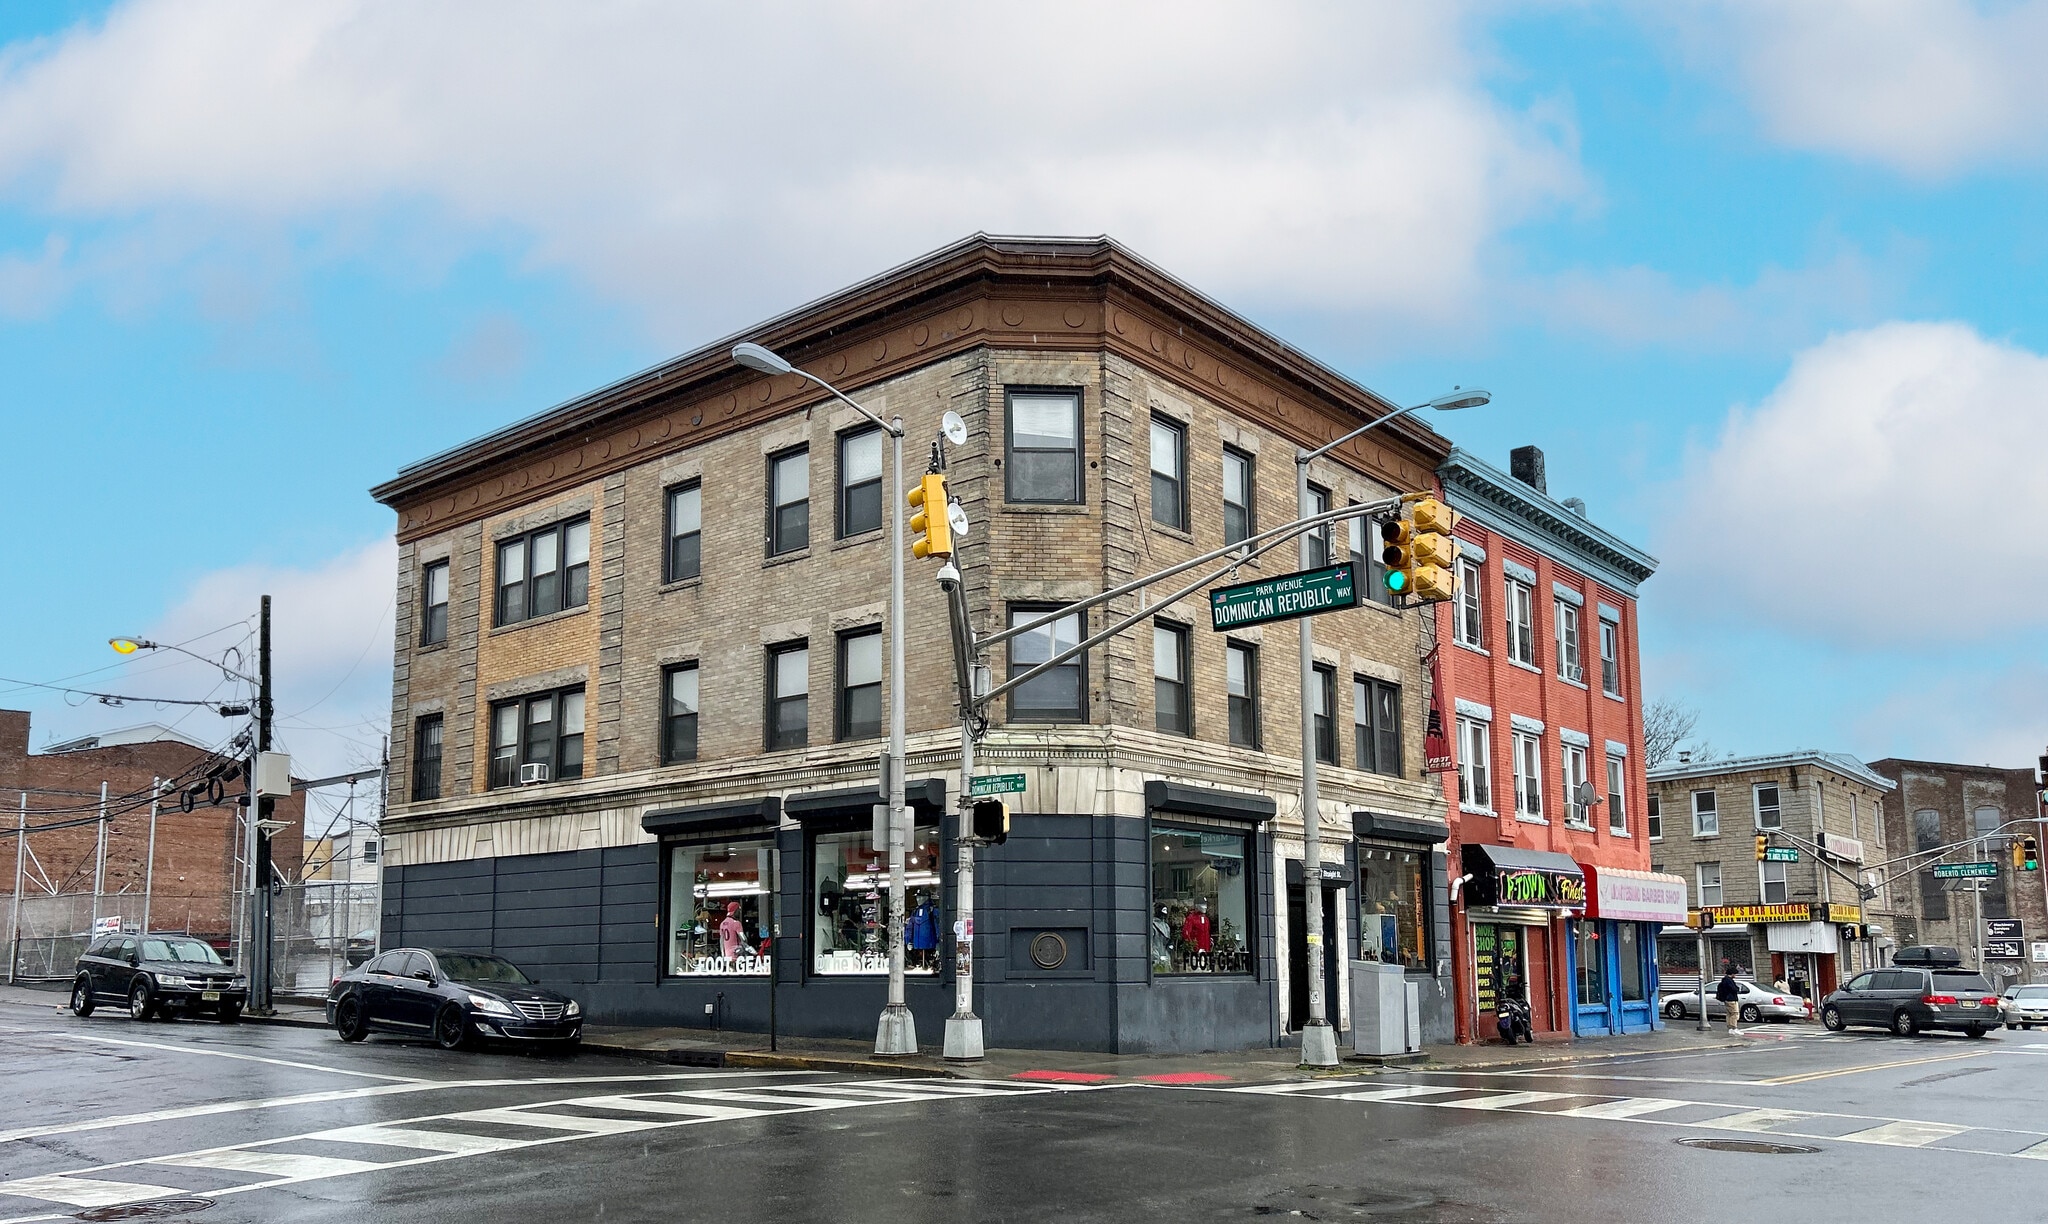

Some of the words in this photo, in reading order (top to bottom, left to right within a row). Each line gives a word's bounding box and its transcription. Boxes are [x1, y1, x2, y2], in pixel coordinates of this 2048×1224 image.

[1256, 585, 1274, 596] PARK
[1276, 579, 1303, 592] AVENUE
[1215, 598, 1274, 624] DOMINICAN
[1278, 586, 1333, 613] REPUBLIC
[1337, 586, 1351, 598] WAY
[1427, 709, 1444, 740] NIKE
[1429, 756, 1450, 764] FOOT
[972, 784, 991, 795] DOMINICAN
[993, 782, 1014, 792] REPUBLIC
[1934, 870, 1958, 878] ROBERTO
[1961, 868, 1988, 876] CLEMENTE
[1641, 887, 1664, 903] BARBER
[1666, 889, 1680, 904] SHOP
[1748, 905, 1765, 915] BAR
[1770, 903, 1809, 915] LIQUORS
[1475, 925, 1495, 937] SMOKE
[1476, 937, 1496, 951] SHOP
[697, 956, 733, 974] FOOT
[735, 955, 771, 974] GEAR
[1183, 952, 1215, 971] FOOT
[1218, 952, 1250, 971] GEAR
[1477, 966, 1492, 975] WRAPS
[1478, 978, 1490, 987] PIPES
[1479, 1001, 1495, 1010] SNACKS
